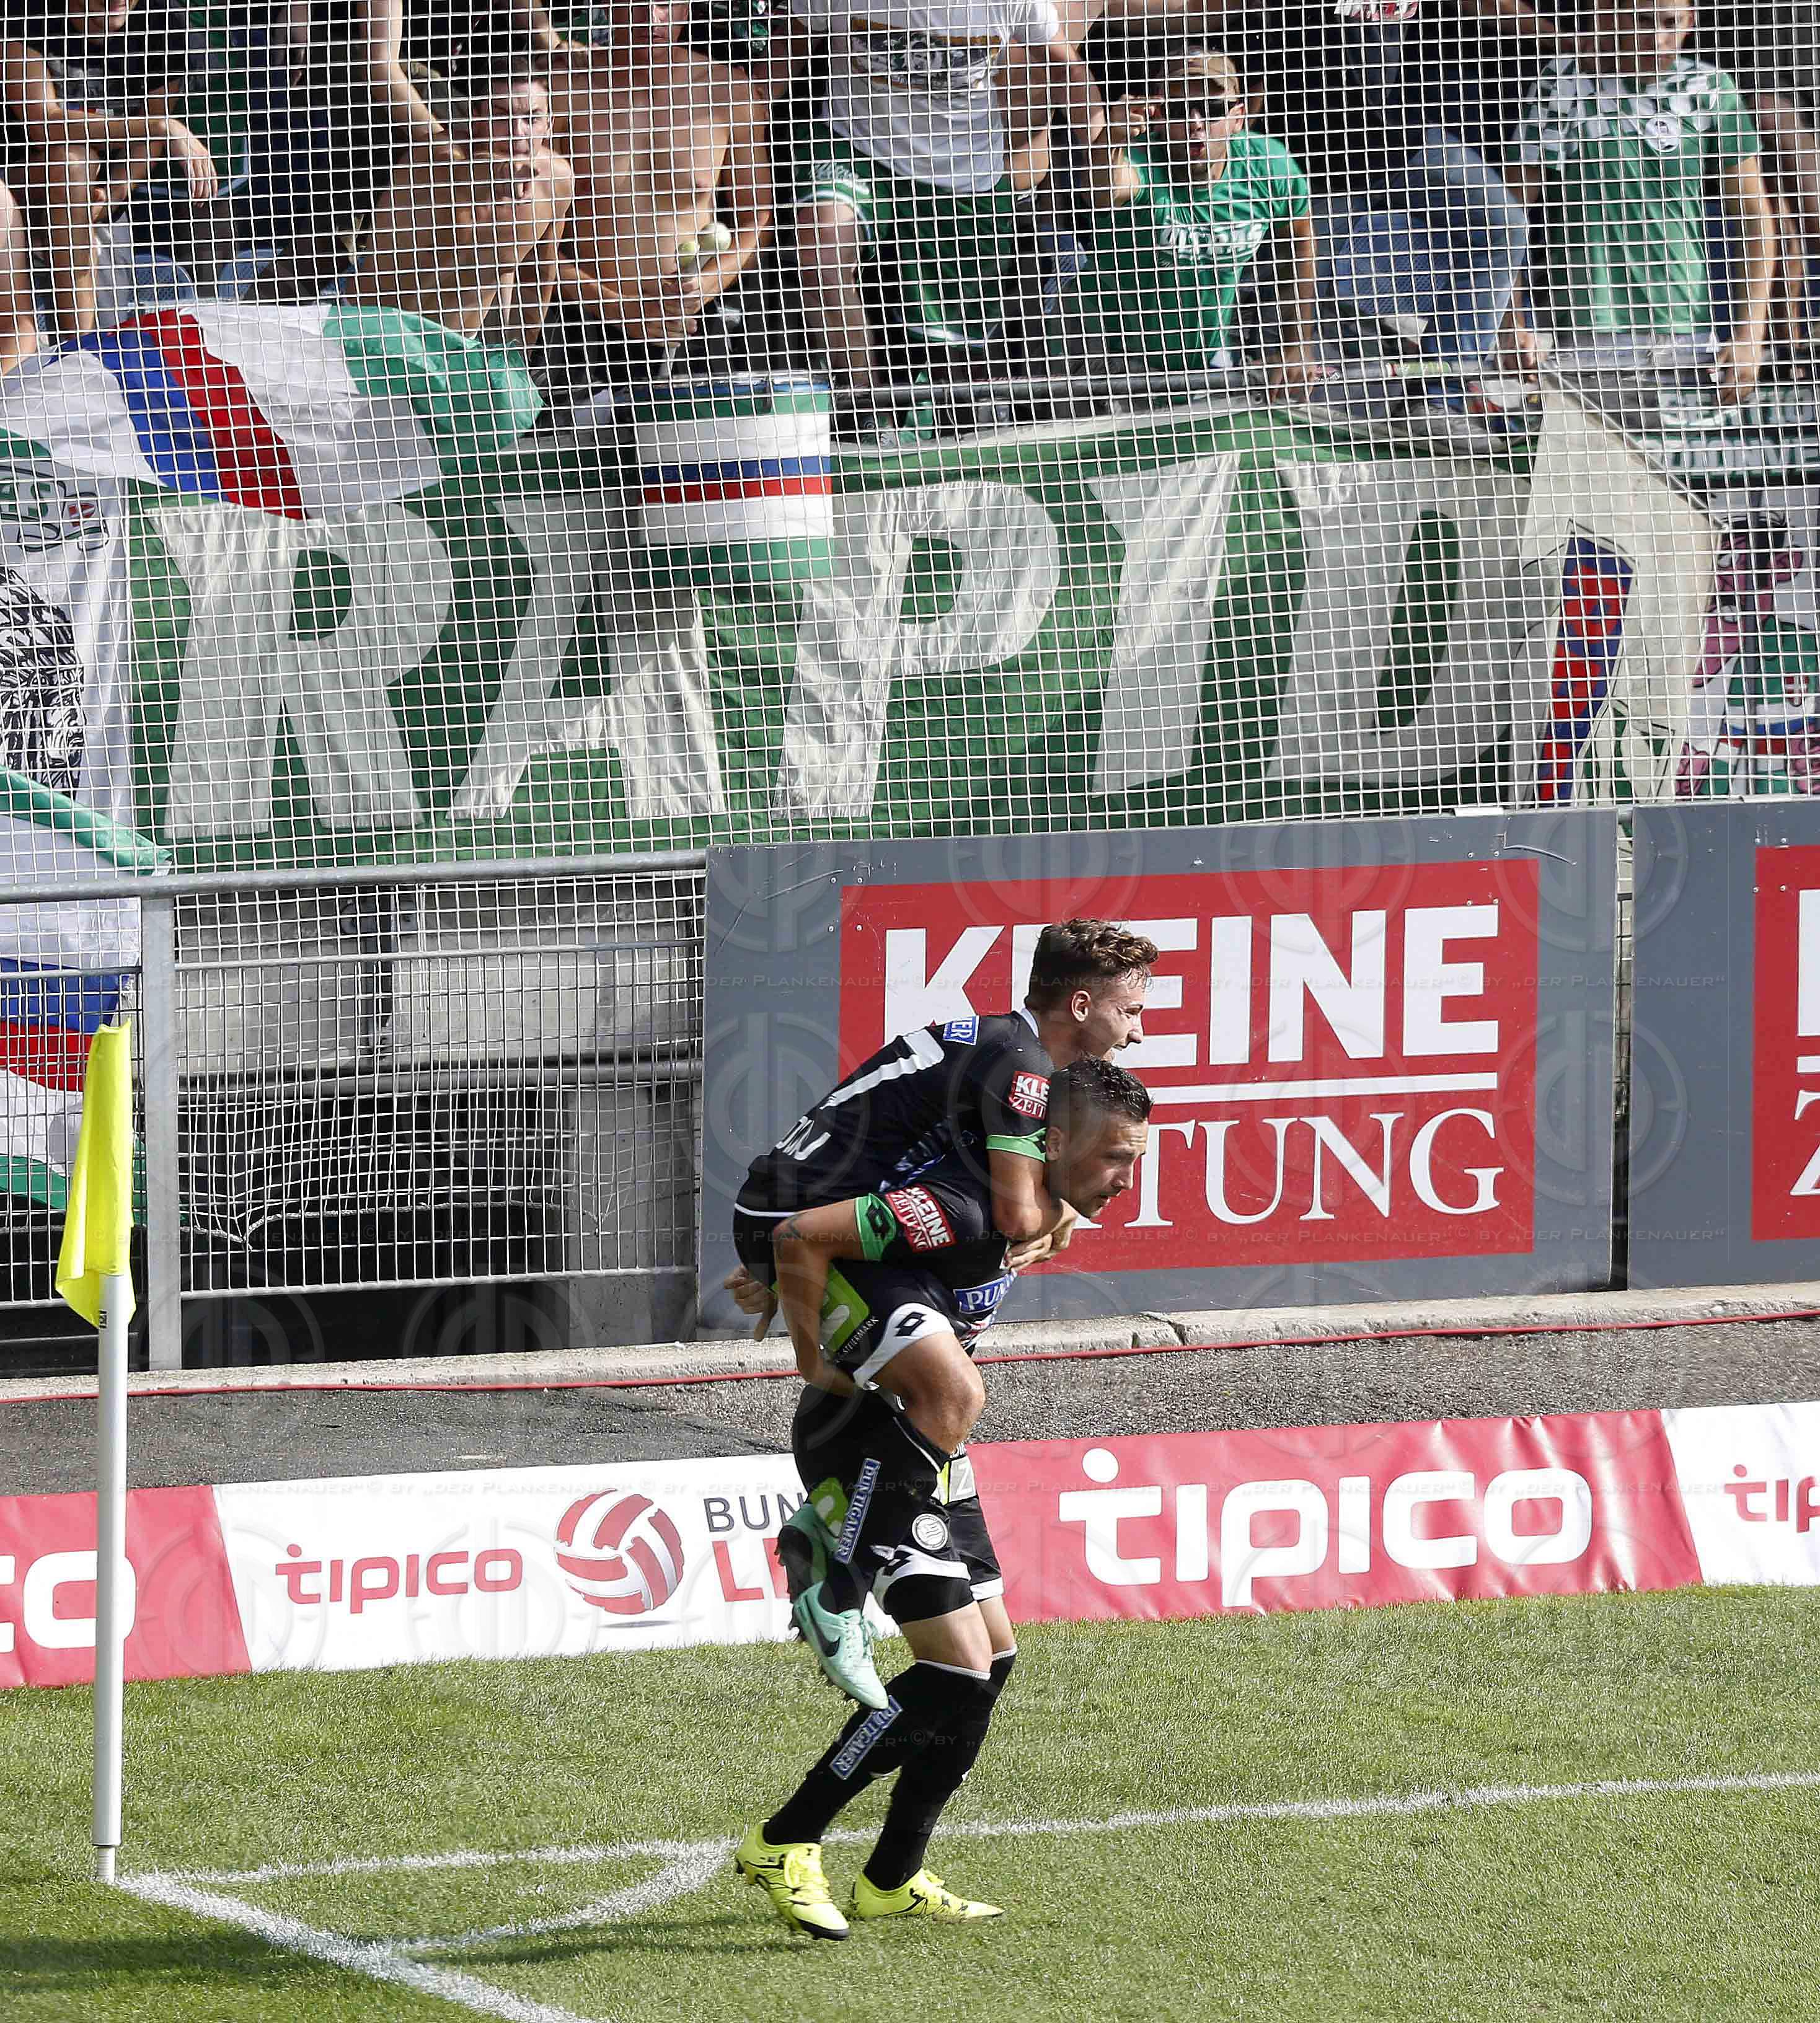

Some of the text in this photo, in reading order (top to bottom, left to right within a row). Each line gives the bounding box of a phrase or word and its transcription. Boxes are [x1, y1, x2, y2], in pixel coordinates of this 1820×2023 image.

[145, 450, 1528, 839] RAPID
[1074, 1108, 1504, 1229] TUNG
[275, 1544, 523, 1615] tipico
[1058, 1448, 1592, 1607] tipico
